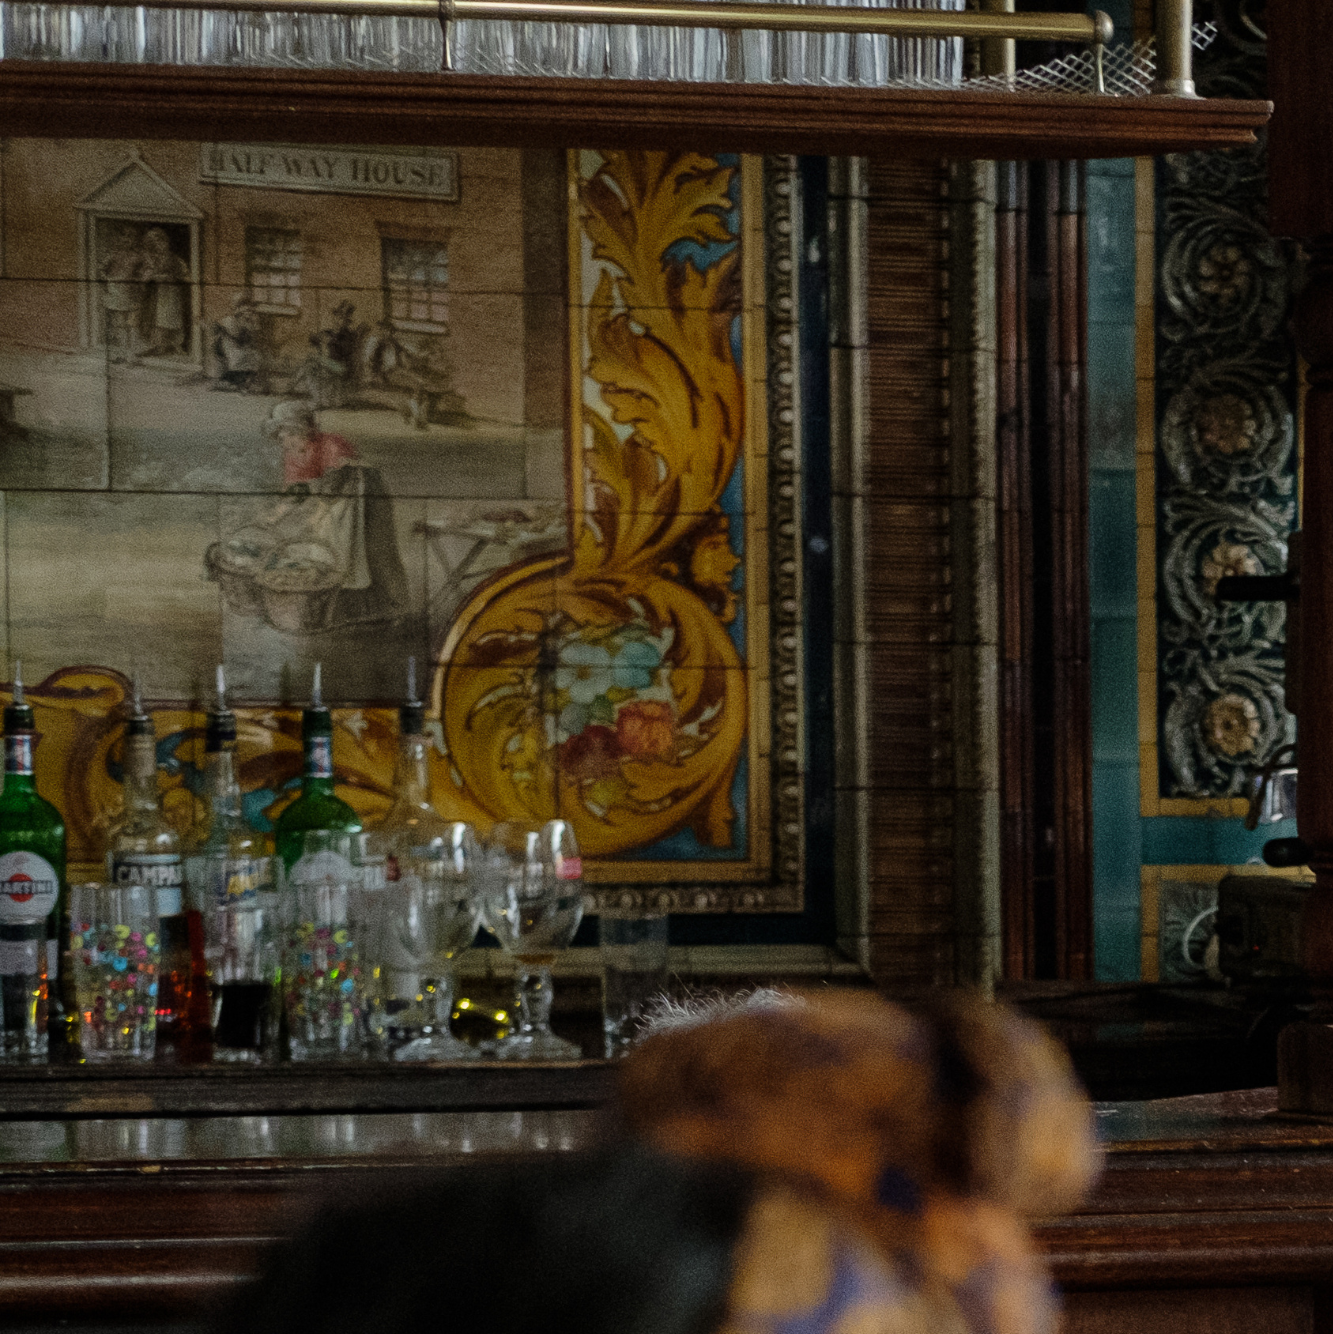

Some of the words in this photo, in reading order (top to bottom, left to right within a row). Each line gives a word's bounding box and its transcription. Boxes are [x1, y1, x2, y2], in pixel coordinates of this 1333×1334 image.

[209, 151, 275, 176] HALF
[281, 153, 341, 180] WAY
[351, 157, 445, 187] HOUSE
[0, 880, 53, 895] ARTINI
